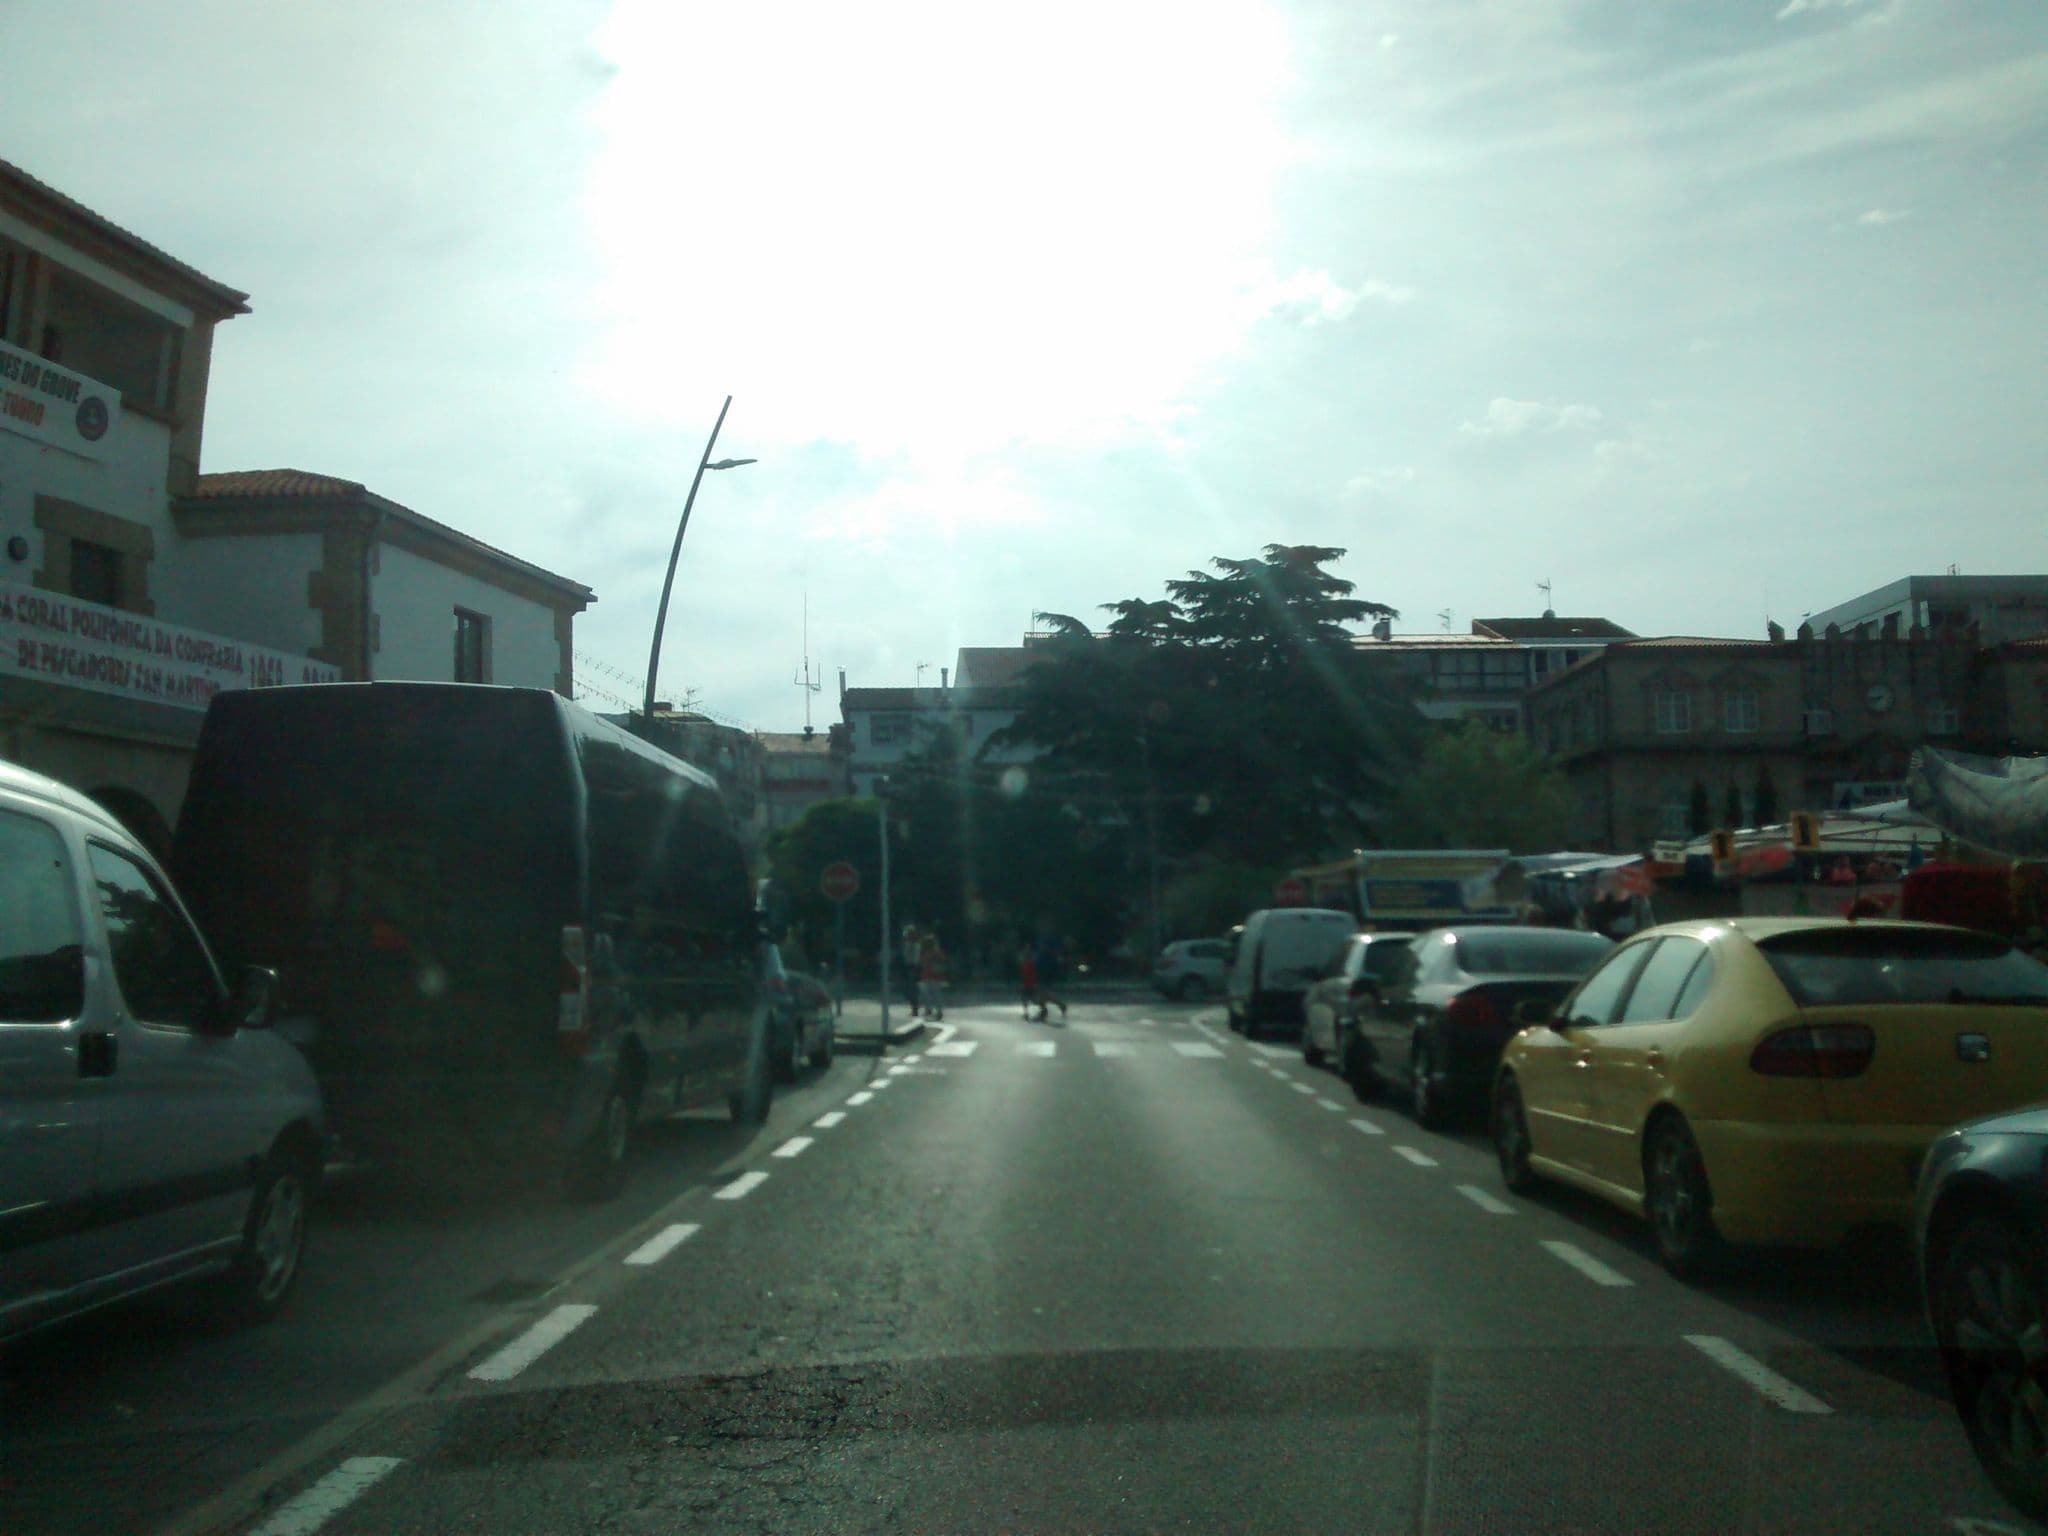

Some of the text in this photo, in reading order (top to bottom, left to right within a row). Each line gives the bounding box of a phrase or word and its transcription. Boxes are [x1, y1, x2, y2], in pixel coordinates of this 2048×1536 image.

[21, 361, 41, 388] DO
[40, 369, 82, 404] GROVE
[16, 594, 67, 633] CORAL
[156, 627, 173, 656] DA
[17, 638, 38, 670] DE
